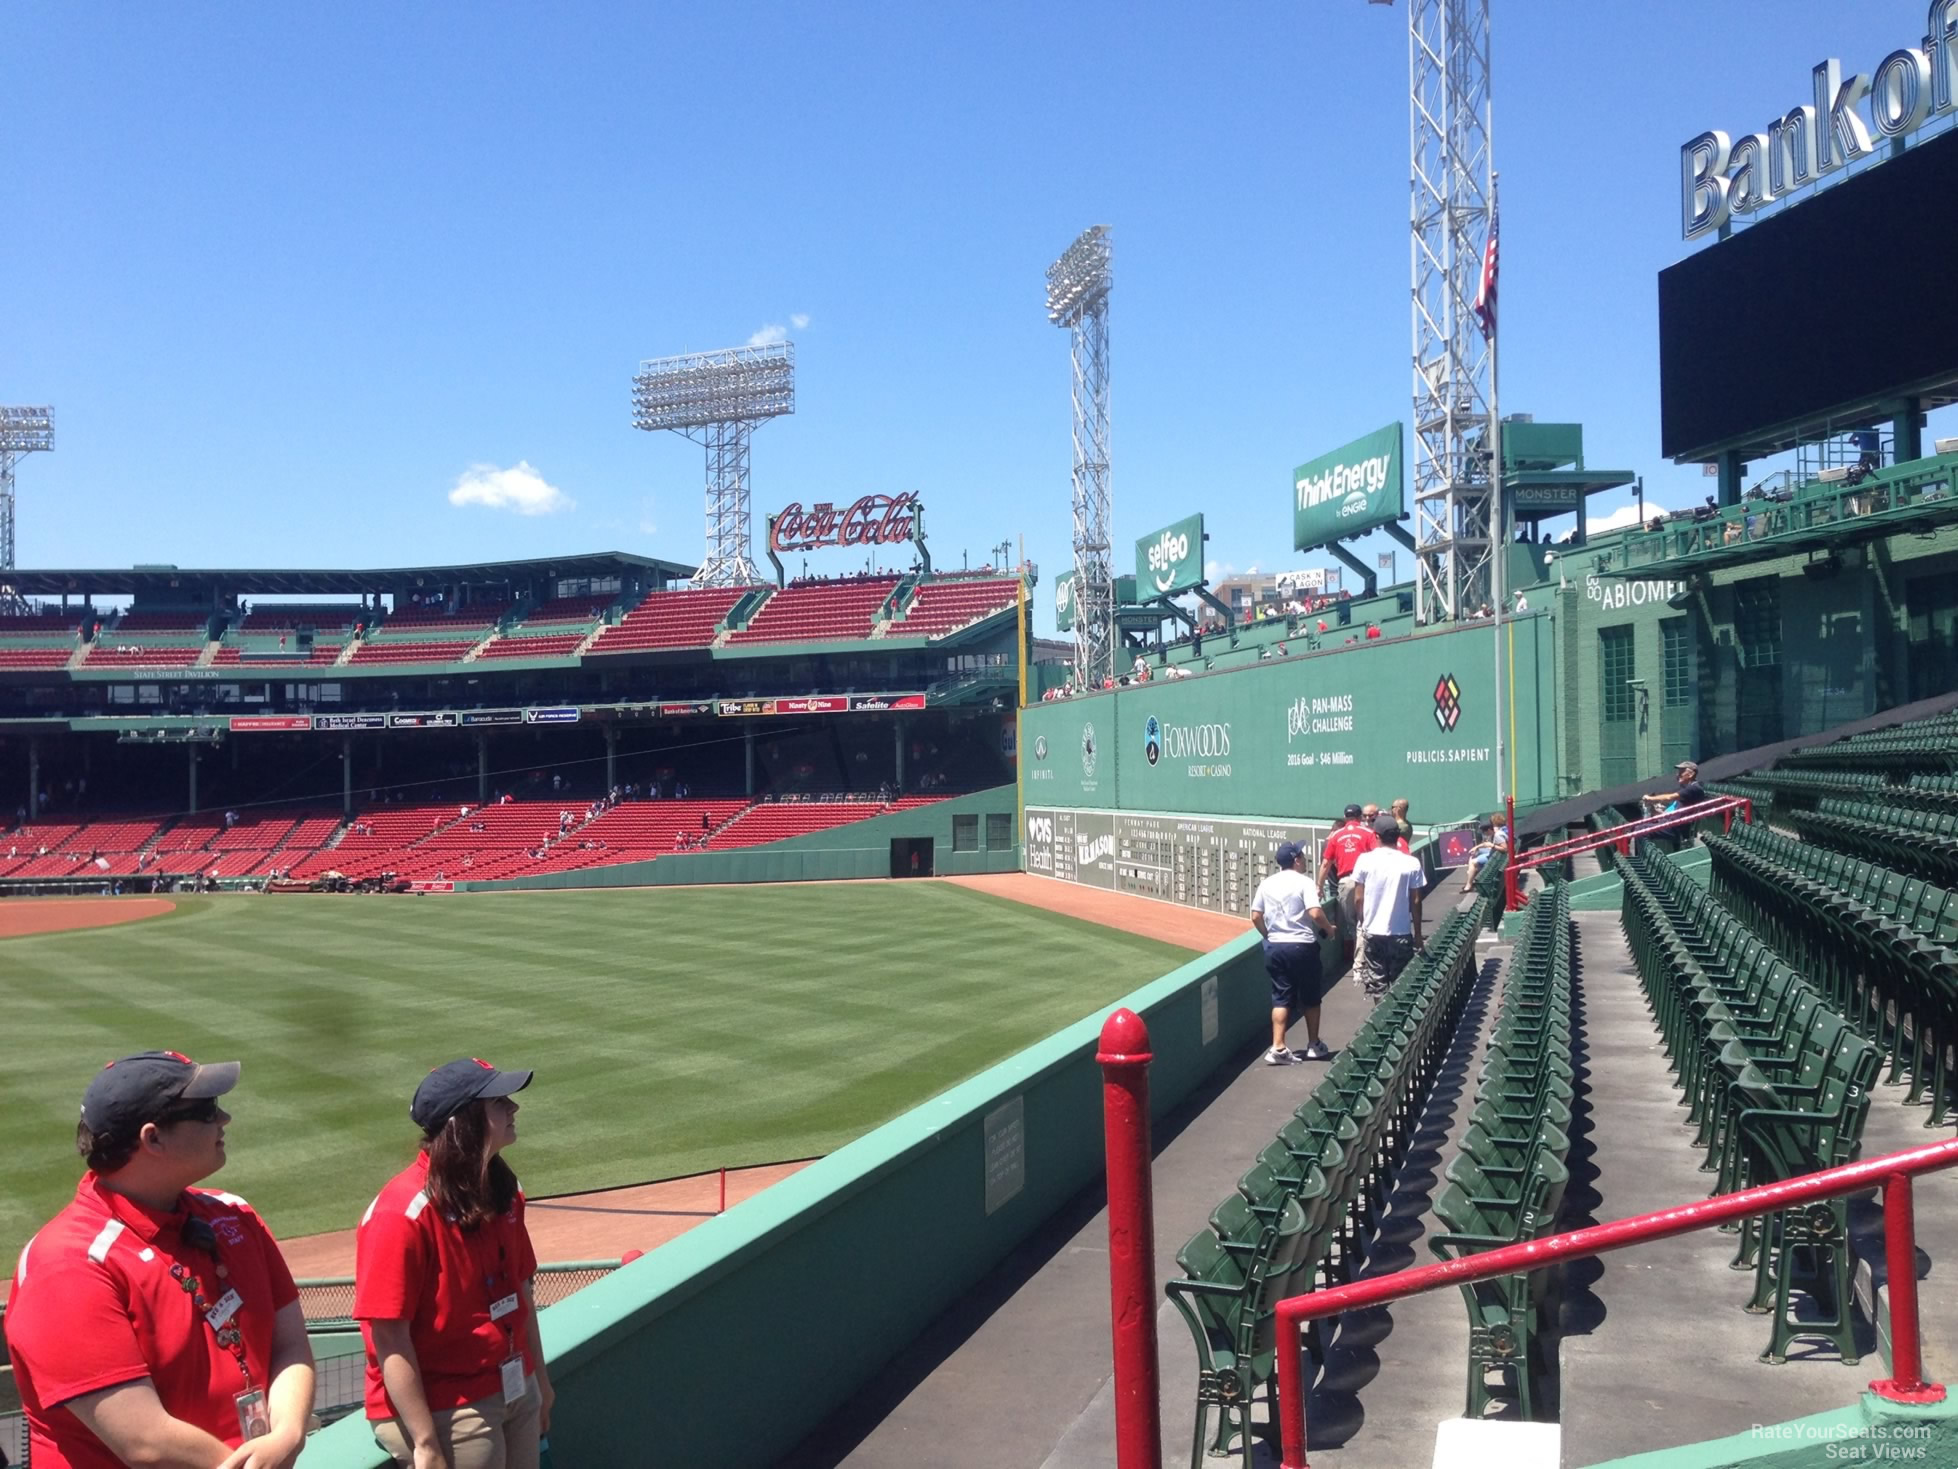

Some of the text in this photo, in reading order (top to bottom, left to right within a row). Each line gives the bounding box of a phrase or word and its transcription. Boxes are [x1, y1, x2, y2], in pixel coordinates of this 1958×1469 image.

[1681, 58, 1873, 241] Bank
[1297, 454, 1390, 511] ThinkEnergy
[1516, 489, 1576, 499] MONSTER
[770, 490, 919, 552] Coca-Cola
[1290, 573, 1311, 581] CASK
[1602, 581, 1684, 611] ABIOME
[1121, 616, 1158, 624] MONSTER
[184, 670, 219, 678] PAVILION
[856, 702, 888, 710] Safelite
[1313, 695, 1352, 714] PAN-MASS
[1313, 716, 1352, 733] CHALLENGE
[1002, 729, 1017, 751] Gul
[1164, 723, 1230, 758] FOXWOODS
[1288, 754, 1300, 766] 2016
[1302, 754, 1314, 766] Goal
[1320, 753, 1331, 766] $46
[1332, 752, 1353, 765] Million
[1407, 748, 1489, 763] PUBLICIS.SAPIENT
[1188, 764, 1231, 776] RESORT CASINO
[1036, 817, 1051, 843] CVS
[1125, 819, 1160, 829] FENWAY PARK
[1177, 823, 1214, 833] AMERICAN LEAGUE
[1243, 828, 1287, 840] NATIONAL LEAGUE
[1030, 844, 1052, 870] Health
[1846, 1085, 1859, 1097] 3
[1523, 1212, 1534, 1224] 2
